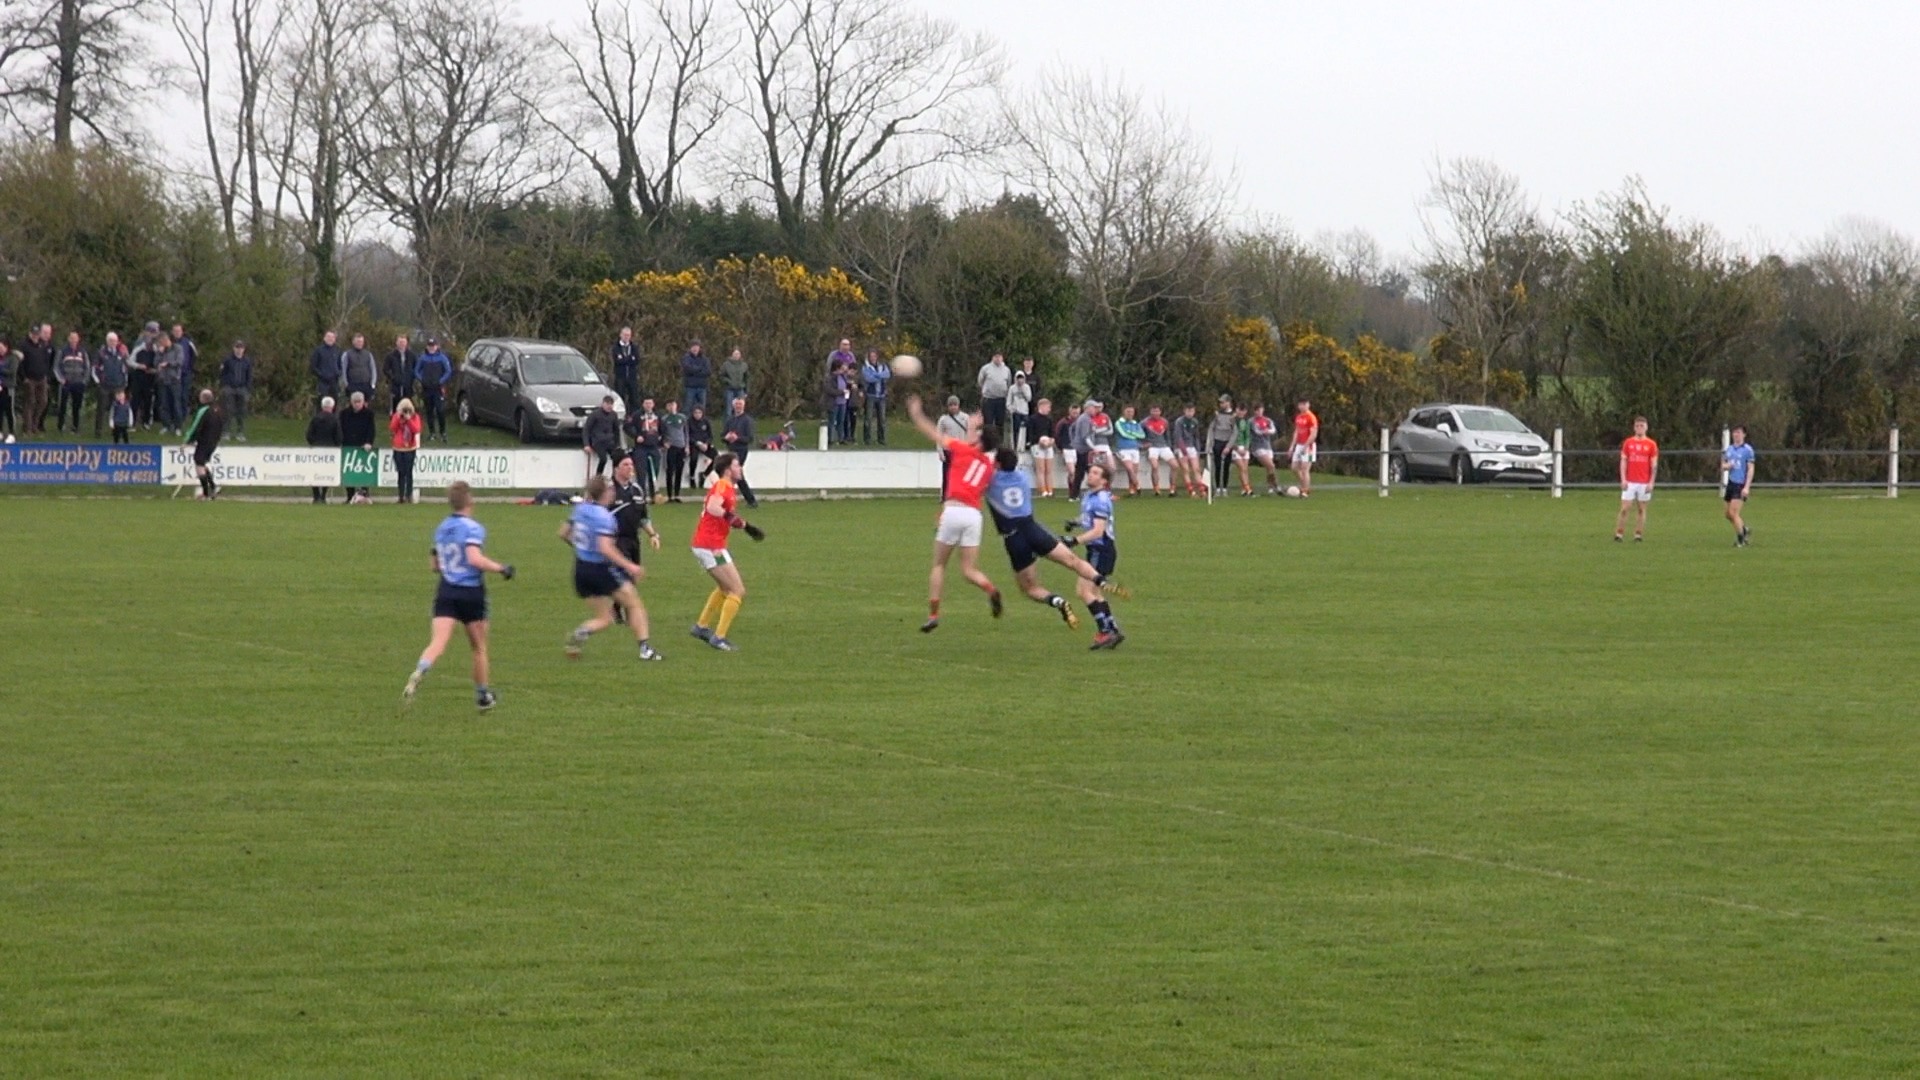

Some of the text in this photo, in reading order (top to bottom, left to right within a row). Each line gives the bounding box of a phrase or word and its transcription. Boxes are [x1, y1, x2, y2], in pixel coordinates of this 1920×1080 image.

[107, 449, 157, 466] BROS.
[263, 454, 336, 463] CRAFT BUTCHER
[342, 449, 377, 474] H&S
[963, 459, 988, 488] 11
[1002, 486, 1024, 508] 8
